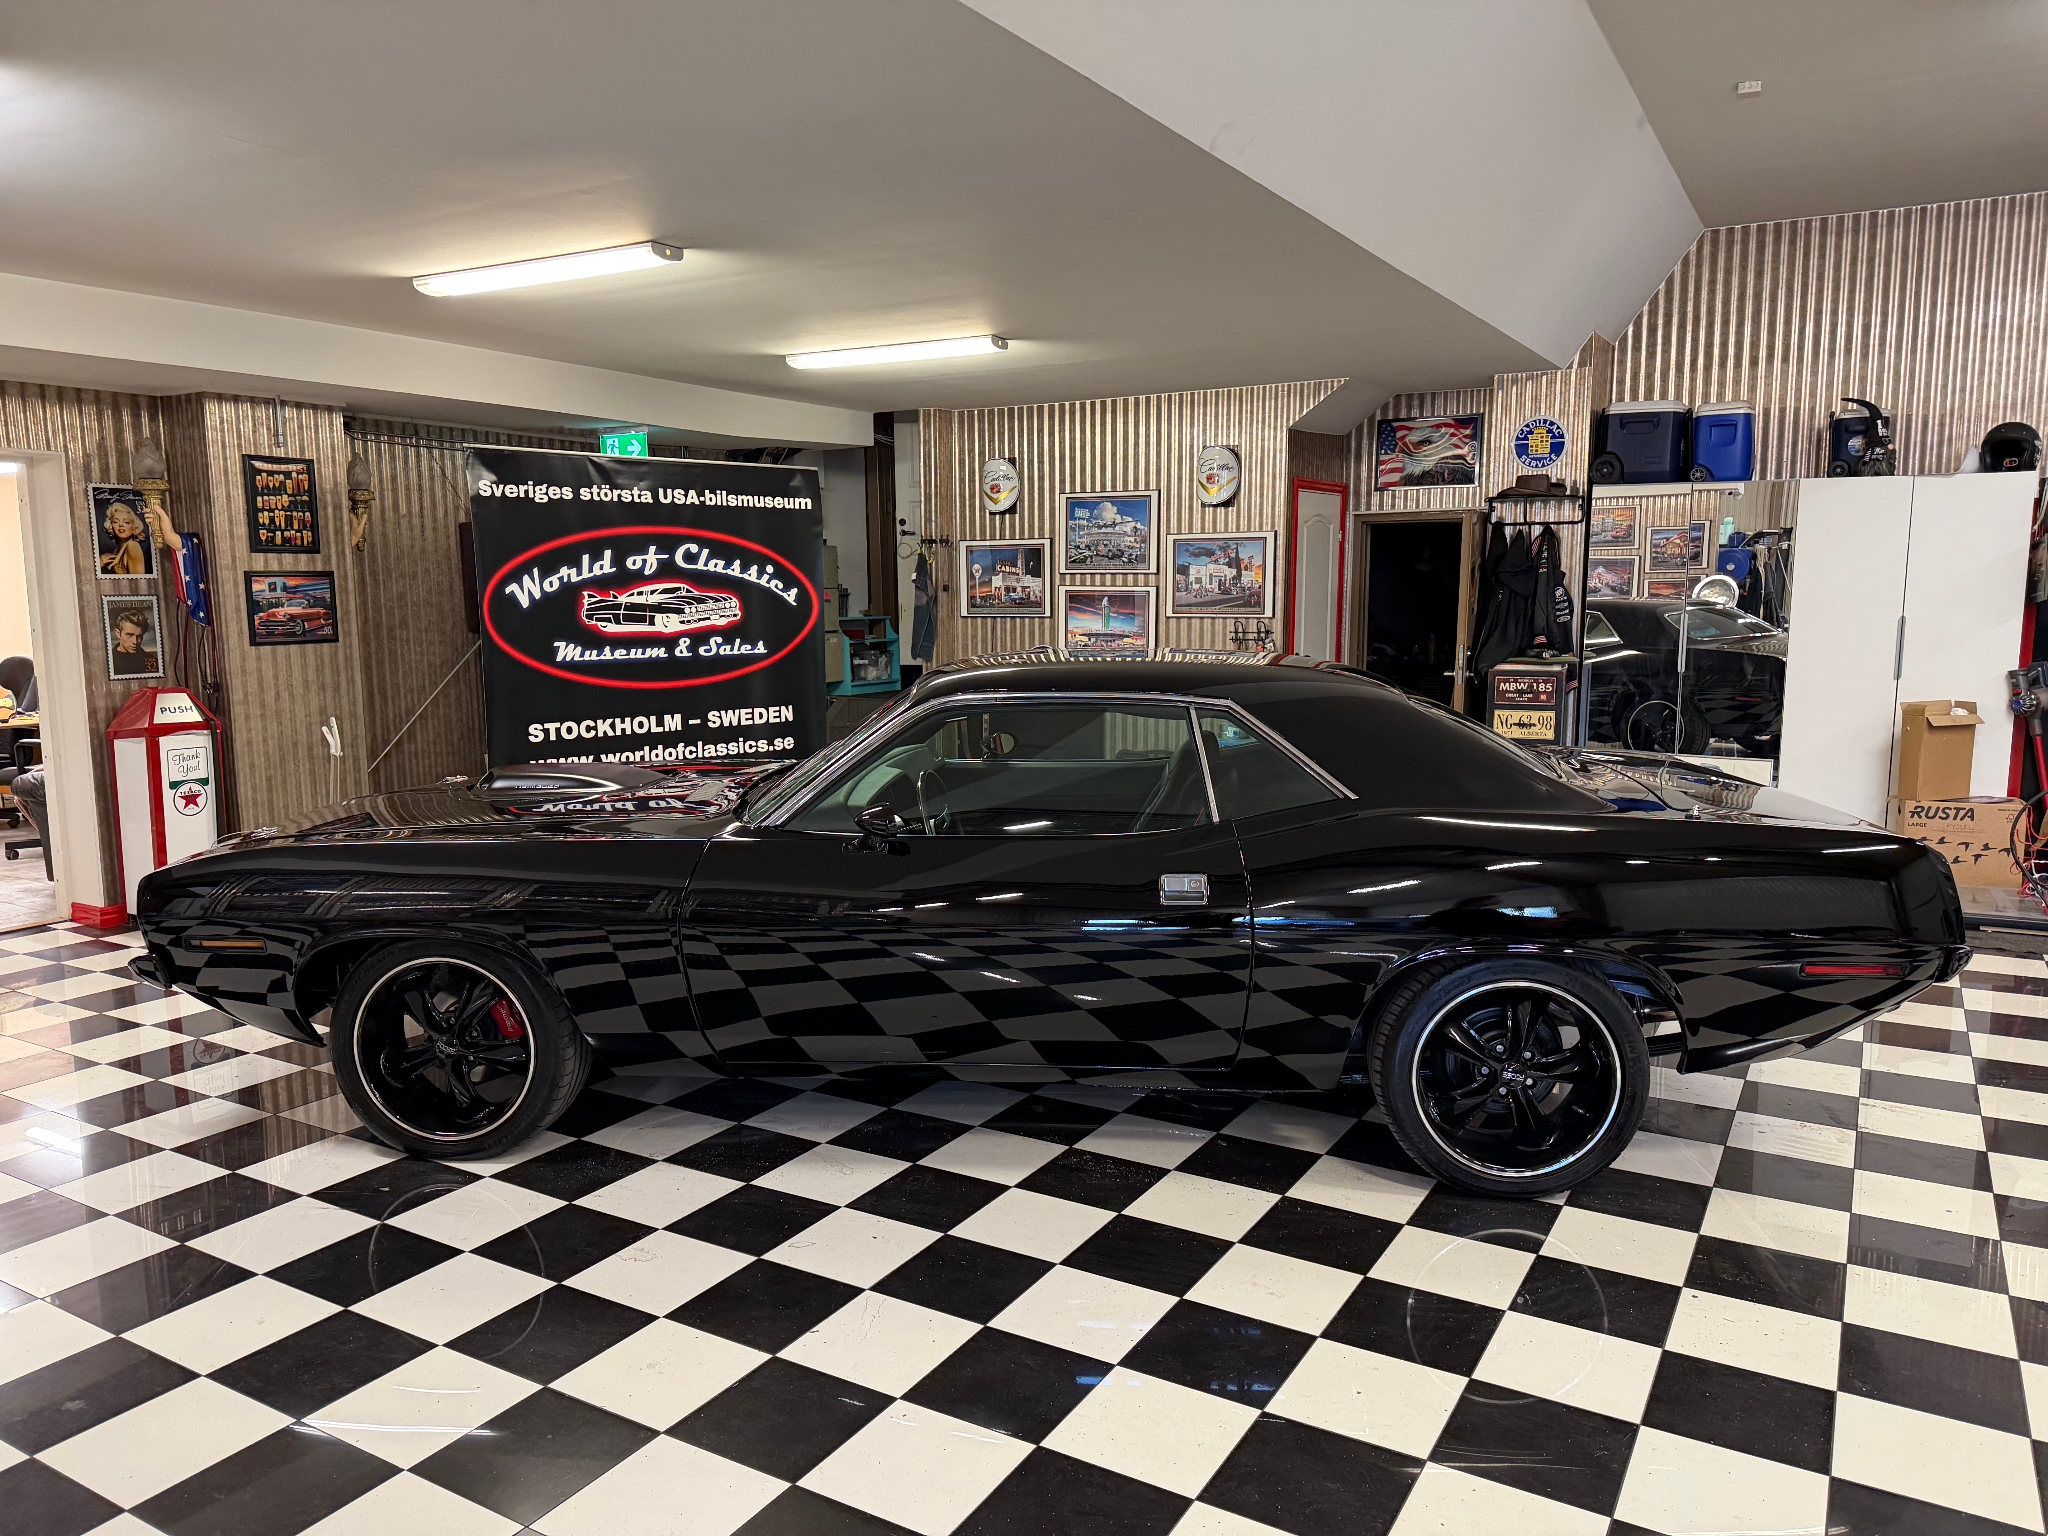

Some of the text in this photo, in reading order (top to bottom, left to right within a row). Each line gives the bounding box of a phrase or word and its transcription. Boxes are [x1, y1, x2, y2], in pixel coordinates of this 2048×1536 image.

[1518, 420, 1562, 438] CADILLAC
[1520, 453, 1557, 467] SERVICE
[478, 479, 812, 510] Sveriges största USA-bilsmuseum
[505, 543, 799, 609] World of Classics
[997, 564, 1020, 574] CABINS
[109, 601, 131, 609] JAMES
[553, 636, 767, 662] Museum & Sales
[145, 661, 157, 672] 32
[1499, 683, 1553, 692] MBW 185
[160, 705, 194, 715] PUSH
[528, 713, 682, 742] STOCKHOLM
[707, 705, 794, 728] SWEDEN
[172, 749, 201, 766] Thank
[178, 761, 201, 778] You!
[1909, 805, 1975, 821] RUSTA
